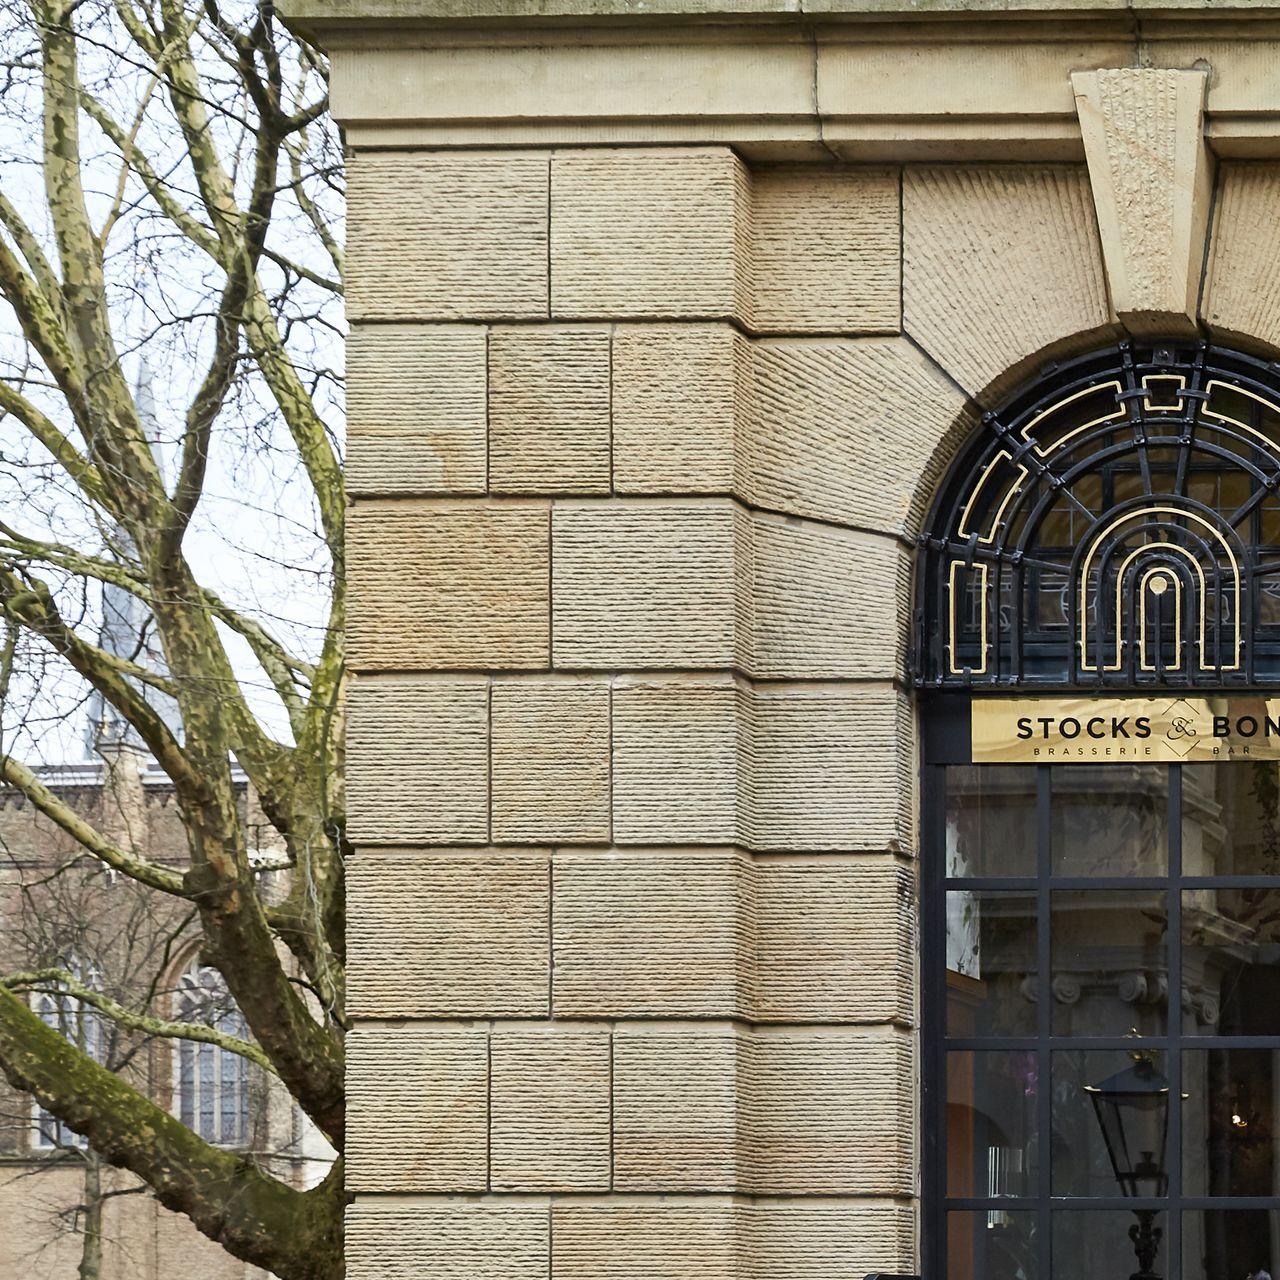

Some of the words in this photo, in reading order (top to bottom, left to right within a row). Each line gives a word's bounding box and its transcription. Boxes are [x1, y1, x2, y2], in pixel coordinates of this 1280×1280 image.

[1017, 717, 1152, 739] STOCKS
[1166, 716, 1197, 740] &
[1033, 748, 1151, 756] BRASSERIE
[1213, 747, 1250, 755] BAR
